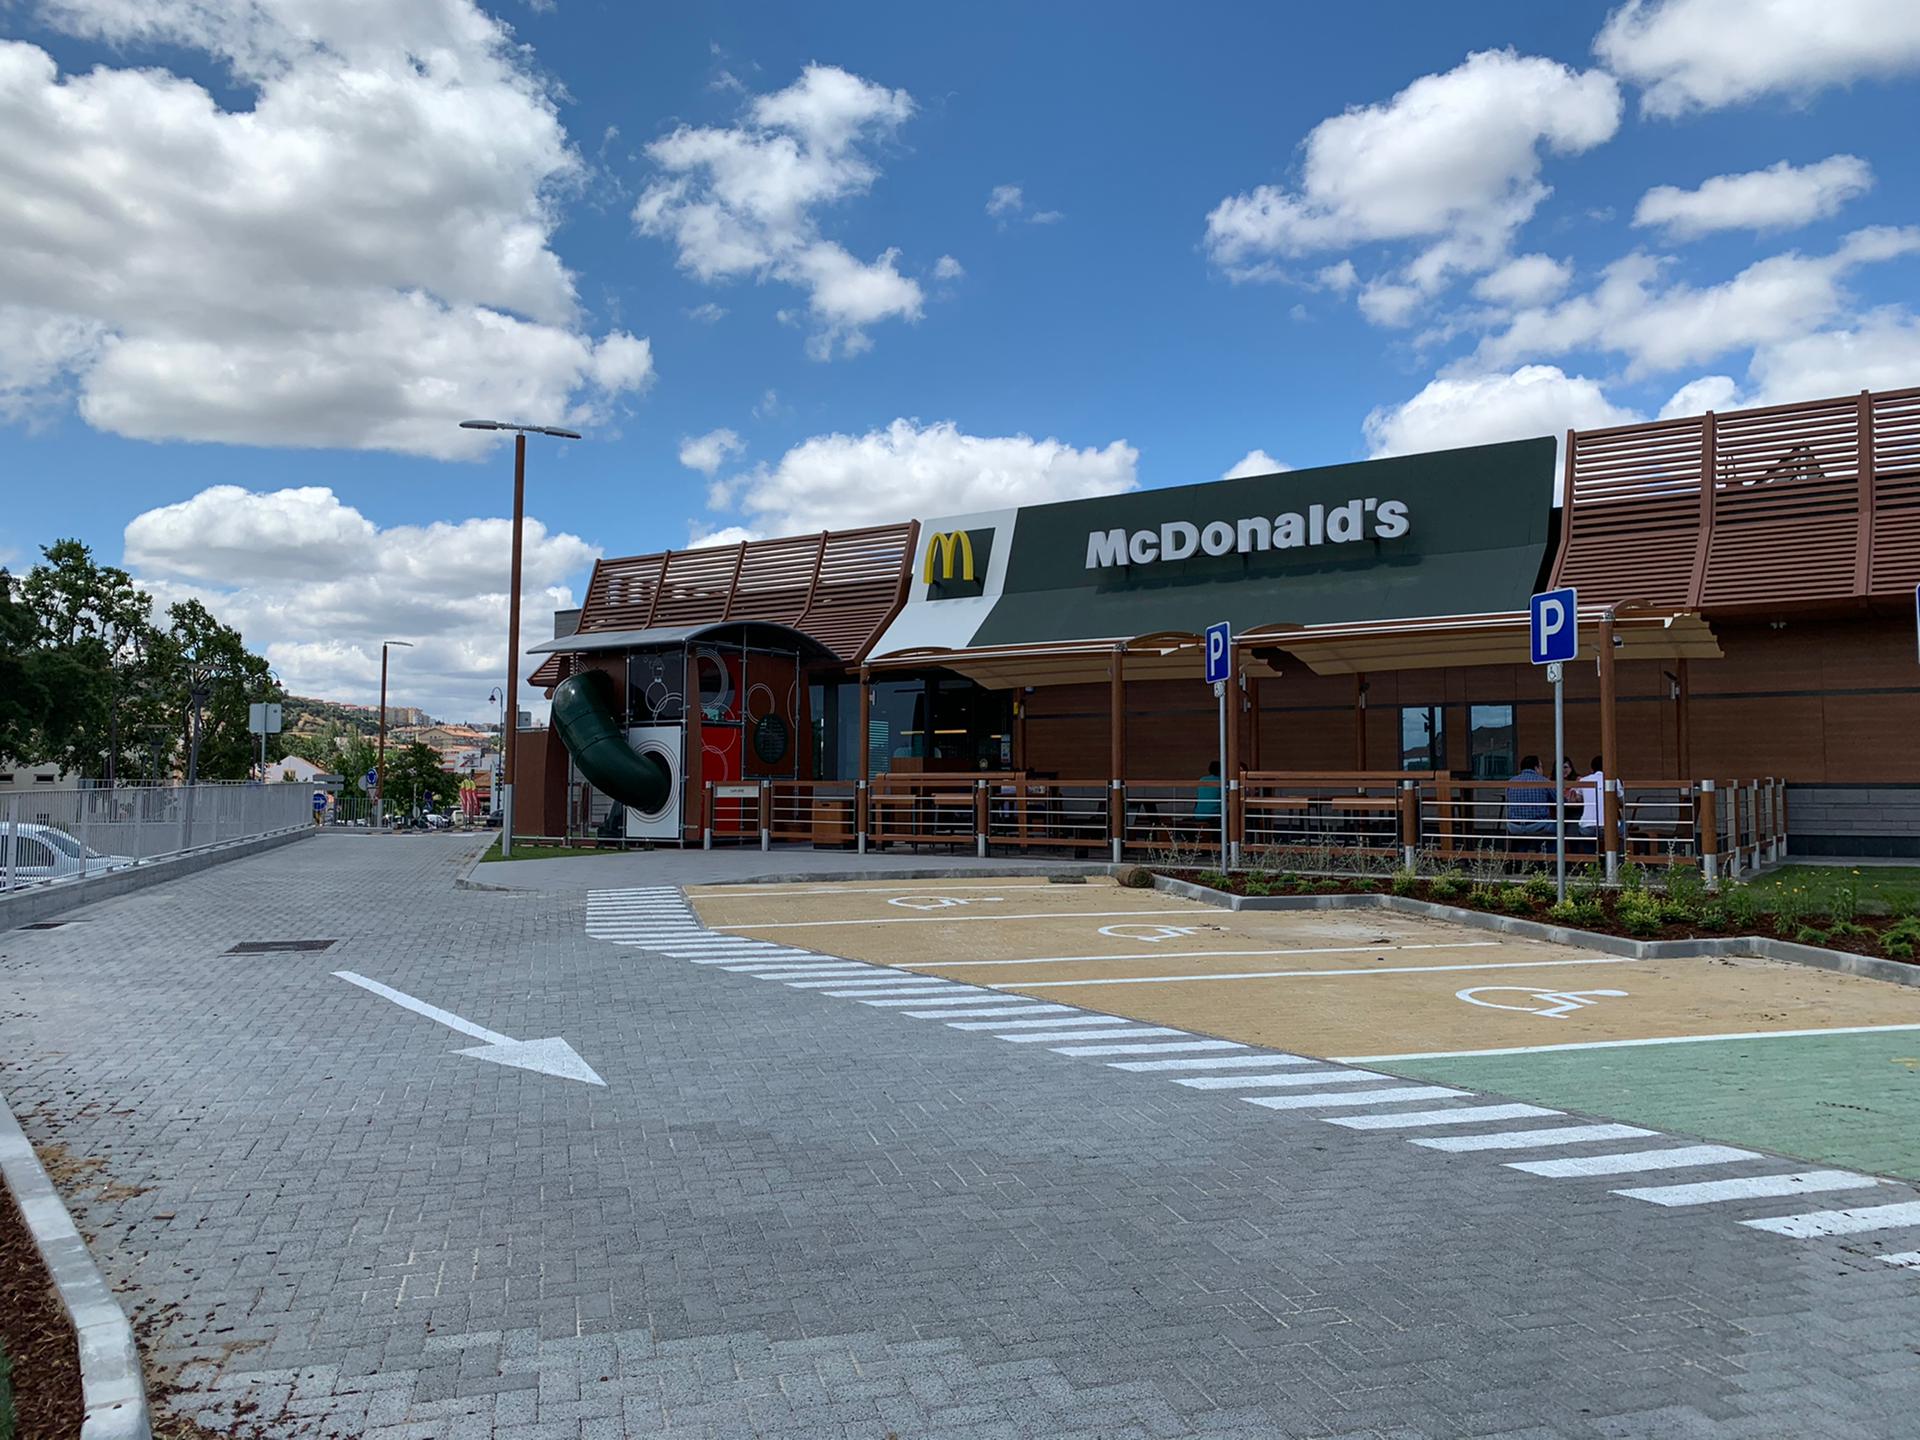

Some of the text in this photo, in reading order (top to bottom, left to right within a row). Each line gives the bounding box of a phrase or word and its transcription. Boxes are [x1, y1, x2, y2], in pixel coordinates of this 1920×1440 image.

[1085, 498, 1409, 569] McDonald's
[1210, 631, 1223, 676] P
[1540, 599, 1564, 655] P
